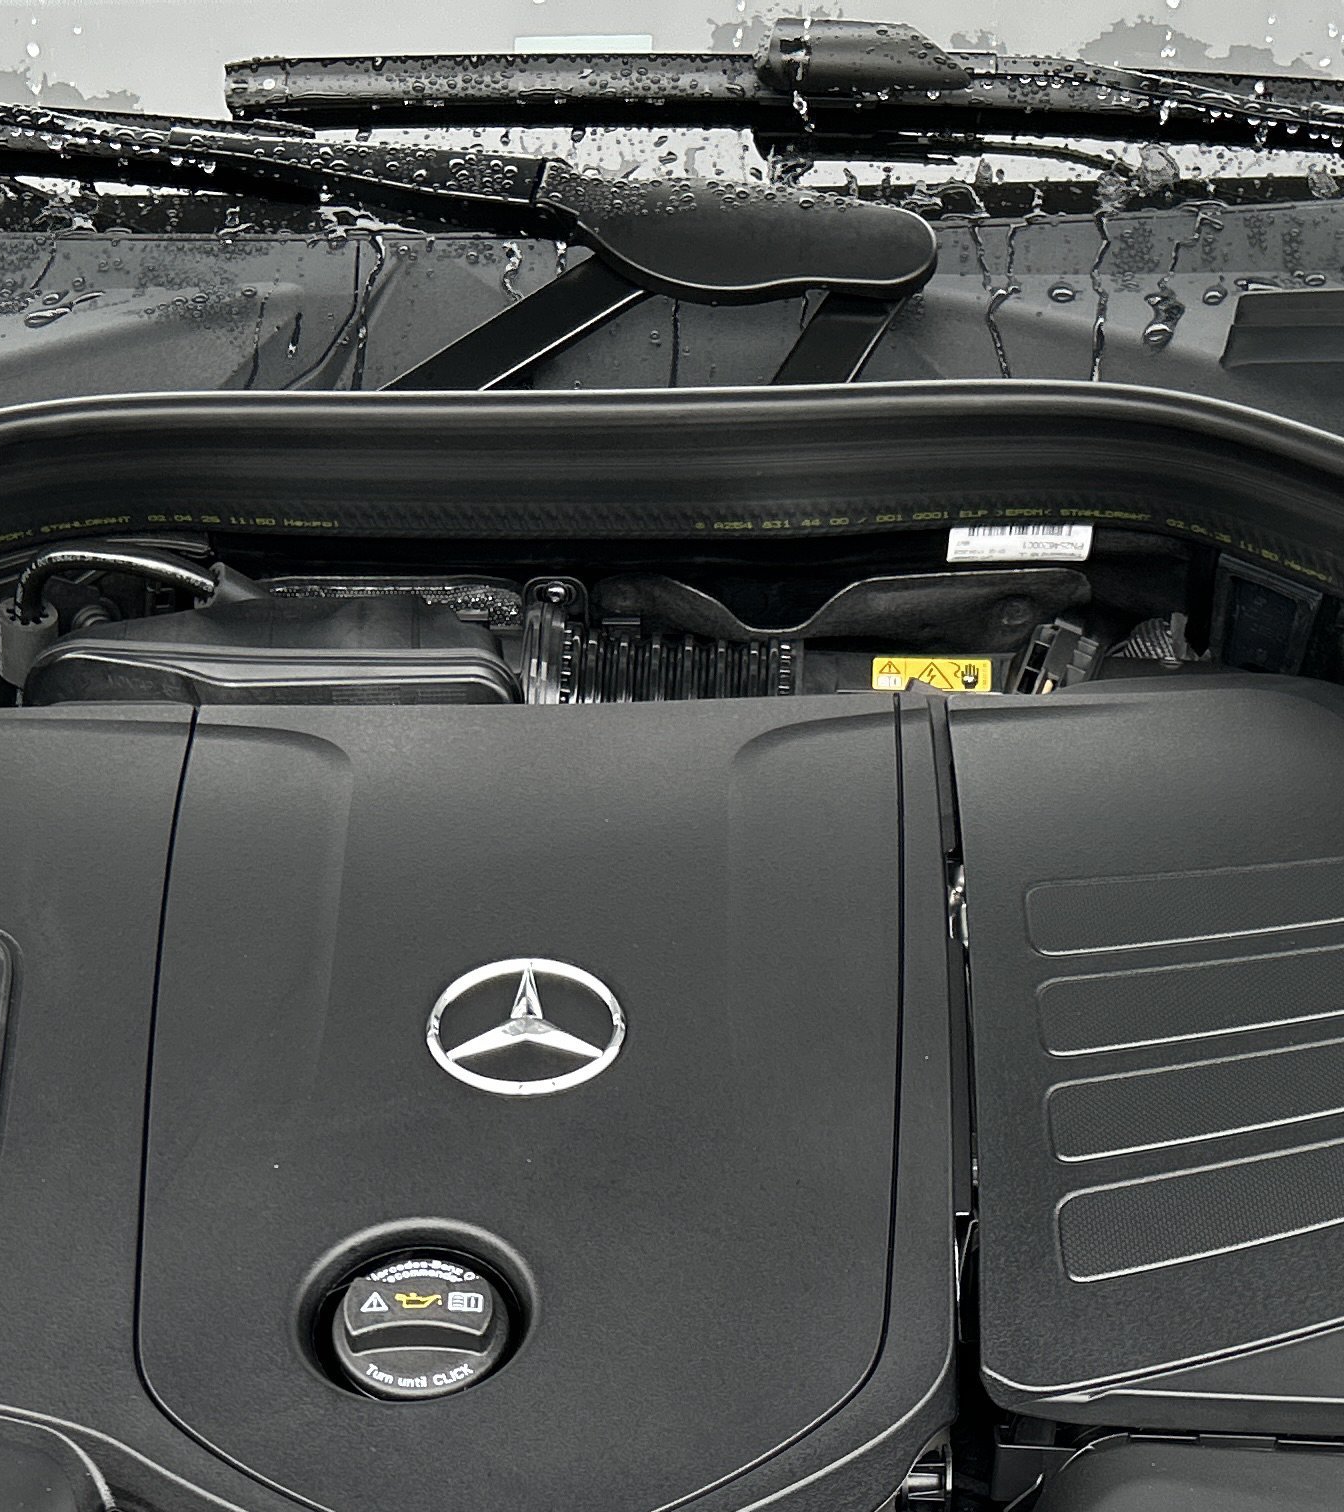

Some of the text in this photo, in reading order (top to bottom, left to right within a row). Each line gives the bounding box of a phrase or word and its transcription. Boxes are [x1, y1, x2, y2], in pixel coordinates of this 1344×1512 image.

[365, 1363, 474, 1389] Turn until CLICK
